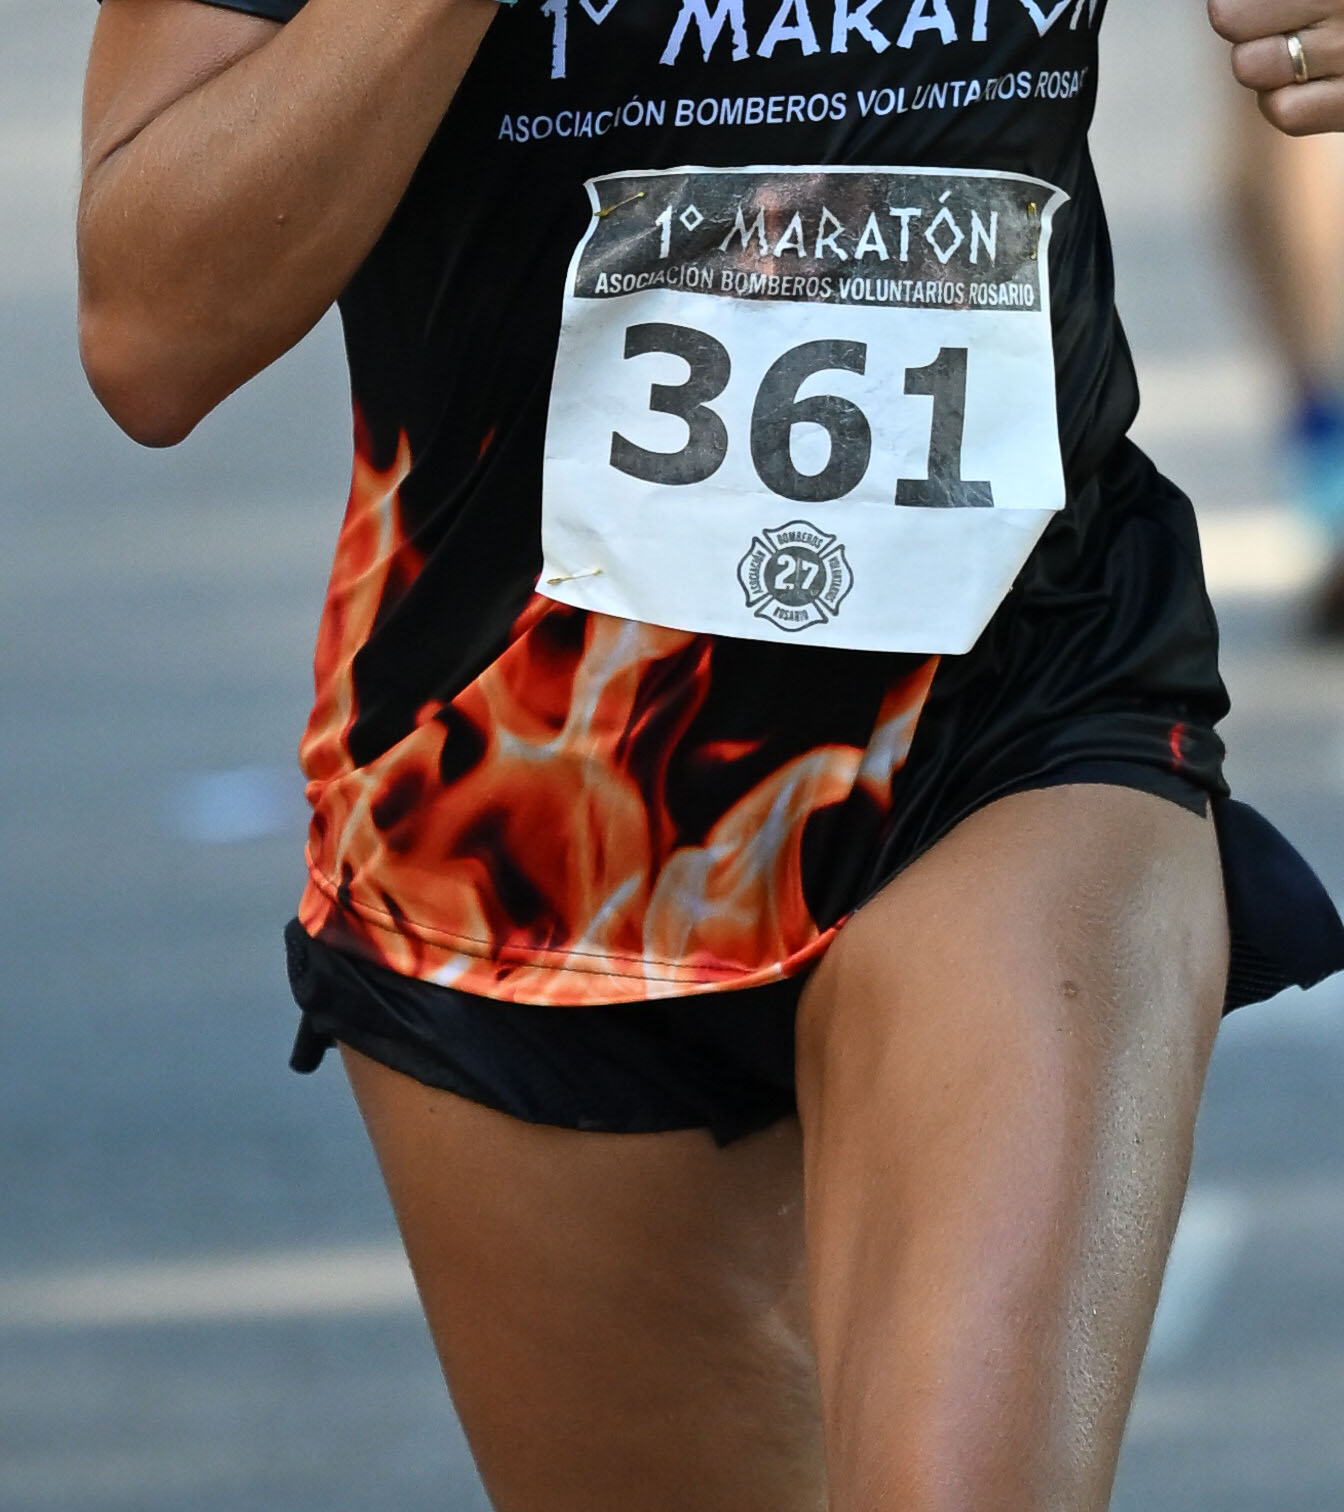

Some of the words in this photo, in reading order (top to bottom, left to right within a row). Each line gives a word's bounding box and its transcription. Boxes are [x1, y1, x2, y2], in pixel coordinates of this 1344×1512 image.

[498, 94, 667, 143] ASOCIACIÓN
[674, 92, 848, 127] BOMBEROS
[718, 190, 999, 265] MARATÓN
[594, 261, 714, 294] ASOCIACIÓN
[720, 269, 832, 299] BOMBEROS
[838, 276, 964, 305] VOLUNTARIOS
[969, 282, 1035, 307] ROSARIO
[608, 321, 995, 509] 361
[774, 554, 819, 590] 27
